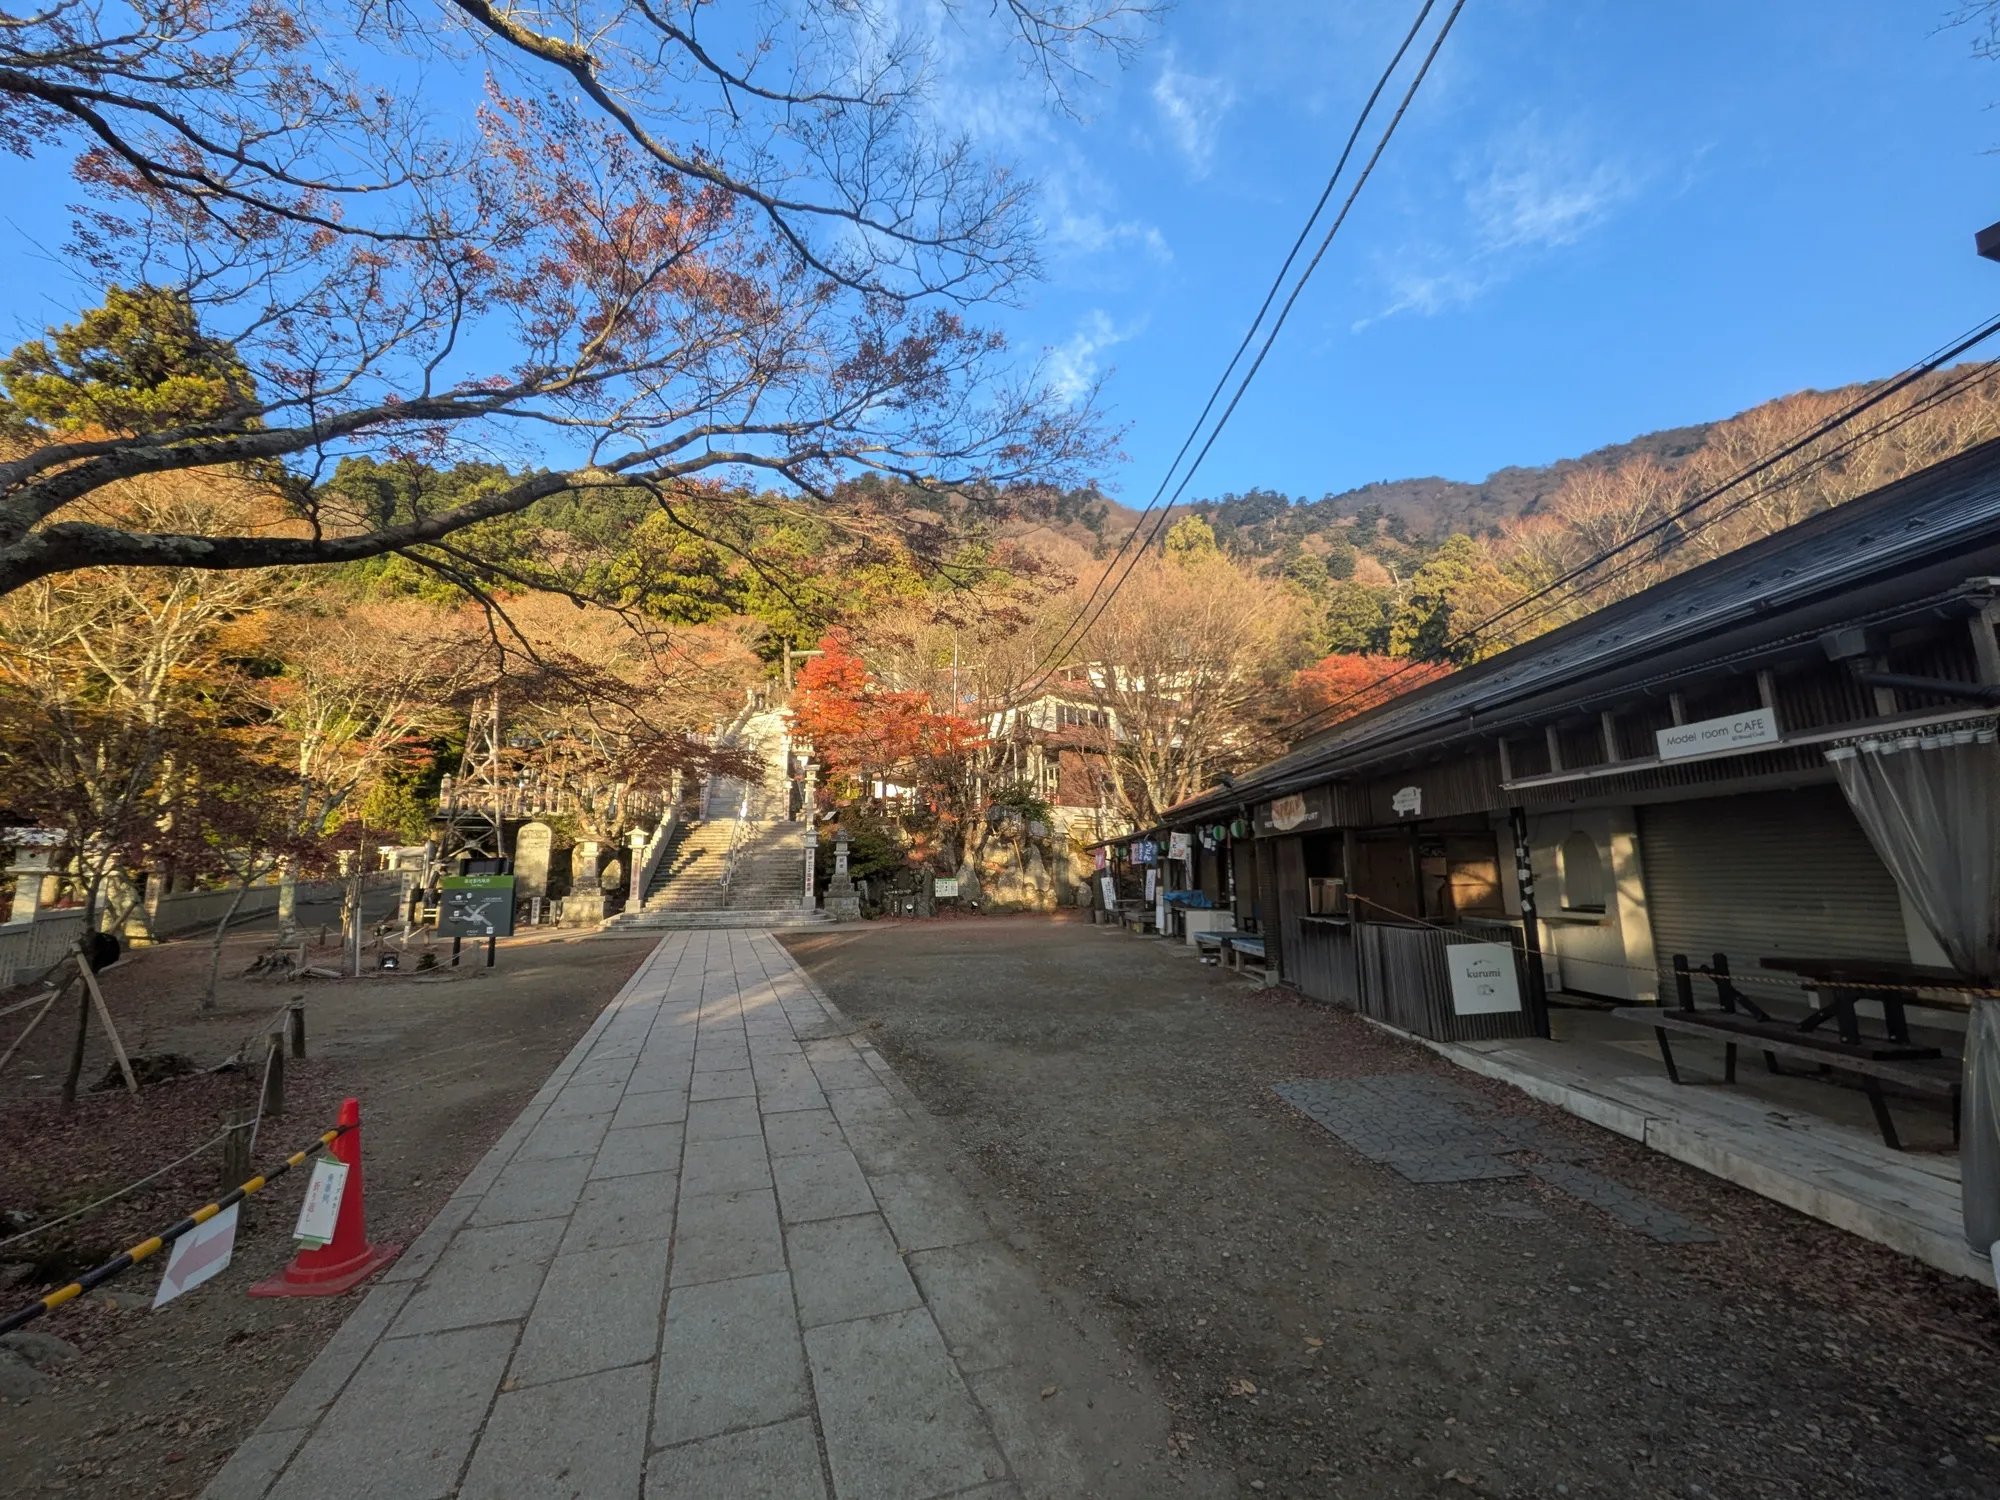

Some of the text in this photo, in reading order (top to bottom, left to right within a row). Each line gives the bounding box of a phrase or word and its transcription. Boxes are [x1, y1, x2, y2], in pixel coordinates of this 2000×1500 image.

[1666, 719, 1764, 746] Model room CAFE
[1466, 968, 1501, 978] kurumi
